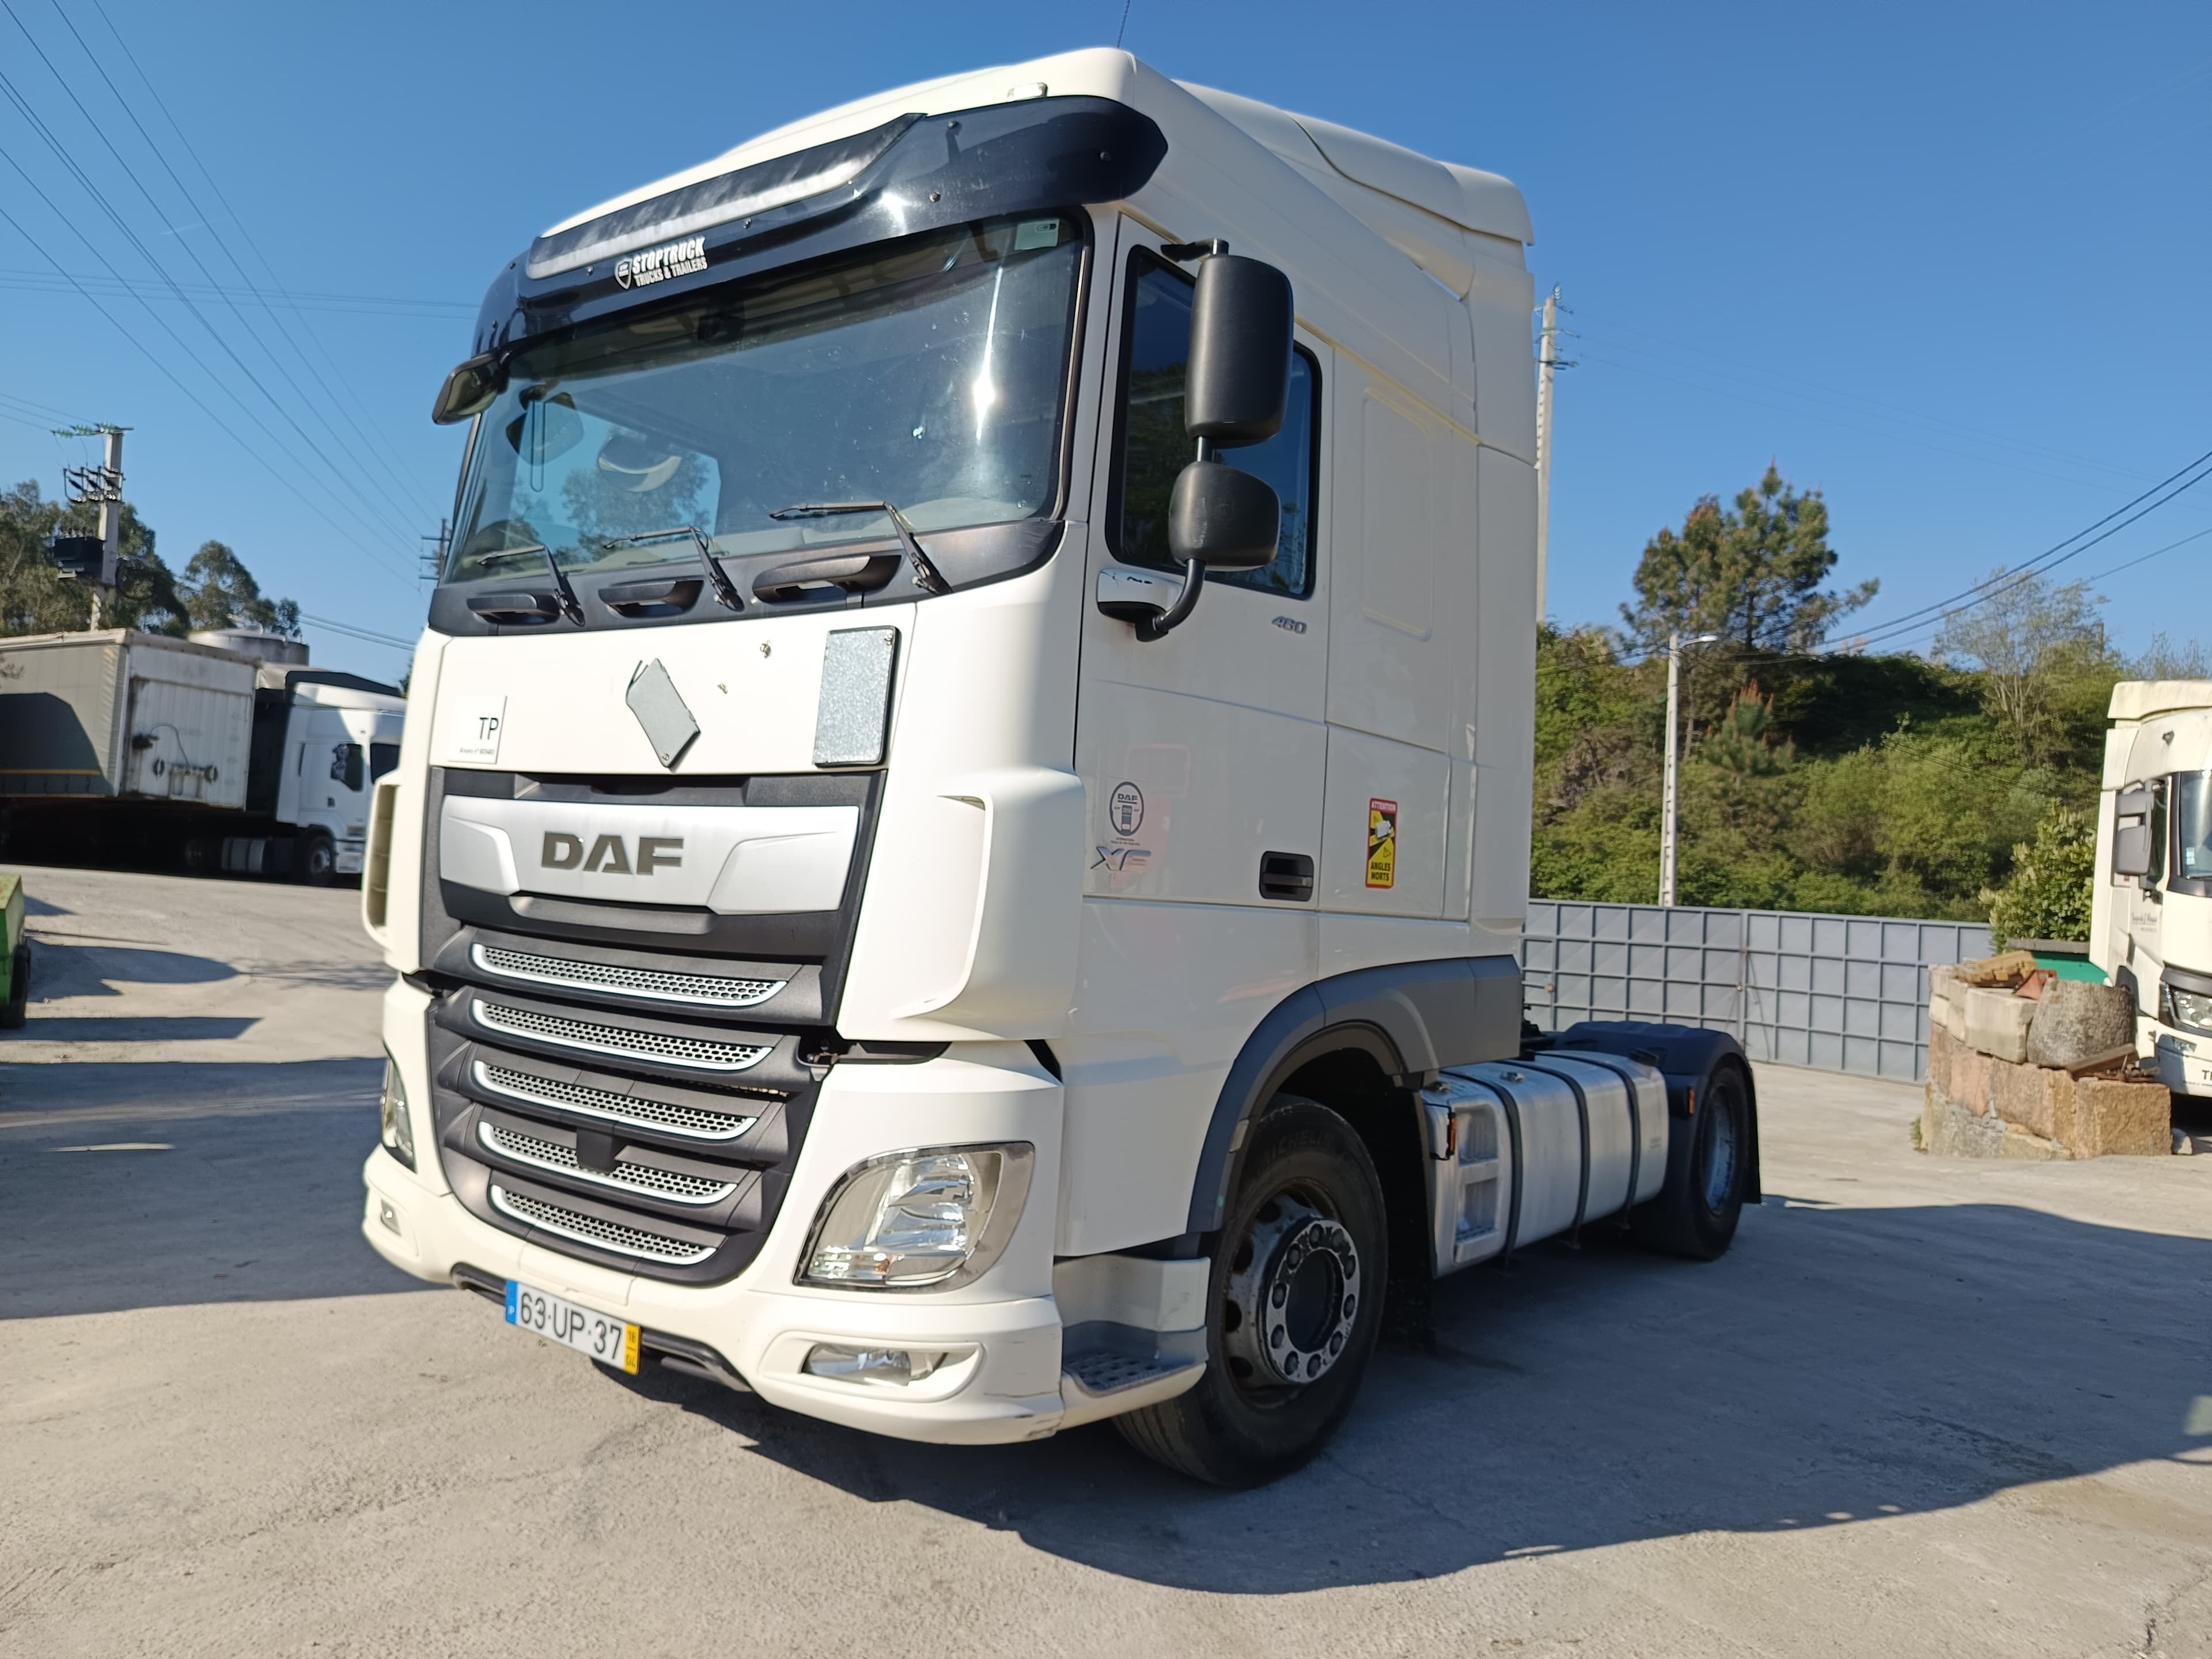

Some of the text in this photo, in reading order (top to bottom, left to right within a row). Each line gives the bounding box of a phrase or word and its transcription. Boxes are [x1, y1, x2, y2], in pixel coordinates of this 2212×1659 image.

[632, 236, 706, 274] STOPTRUCK
[634, 257, 708, 287] TRUCKS & TRAILERS
[479, 717, 499, 740] TP
[1118, 793, 1138, 801] DAF
[541, 831, 684, 875] DAF
[1371, 861, 1391, 872] ANGLES
[1371, 872, 1389, 881] MORTS
